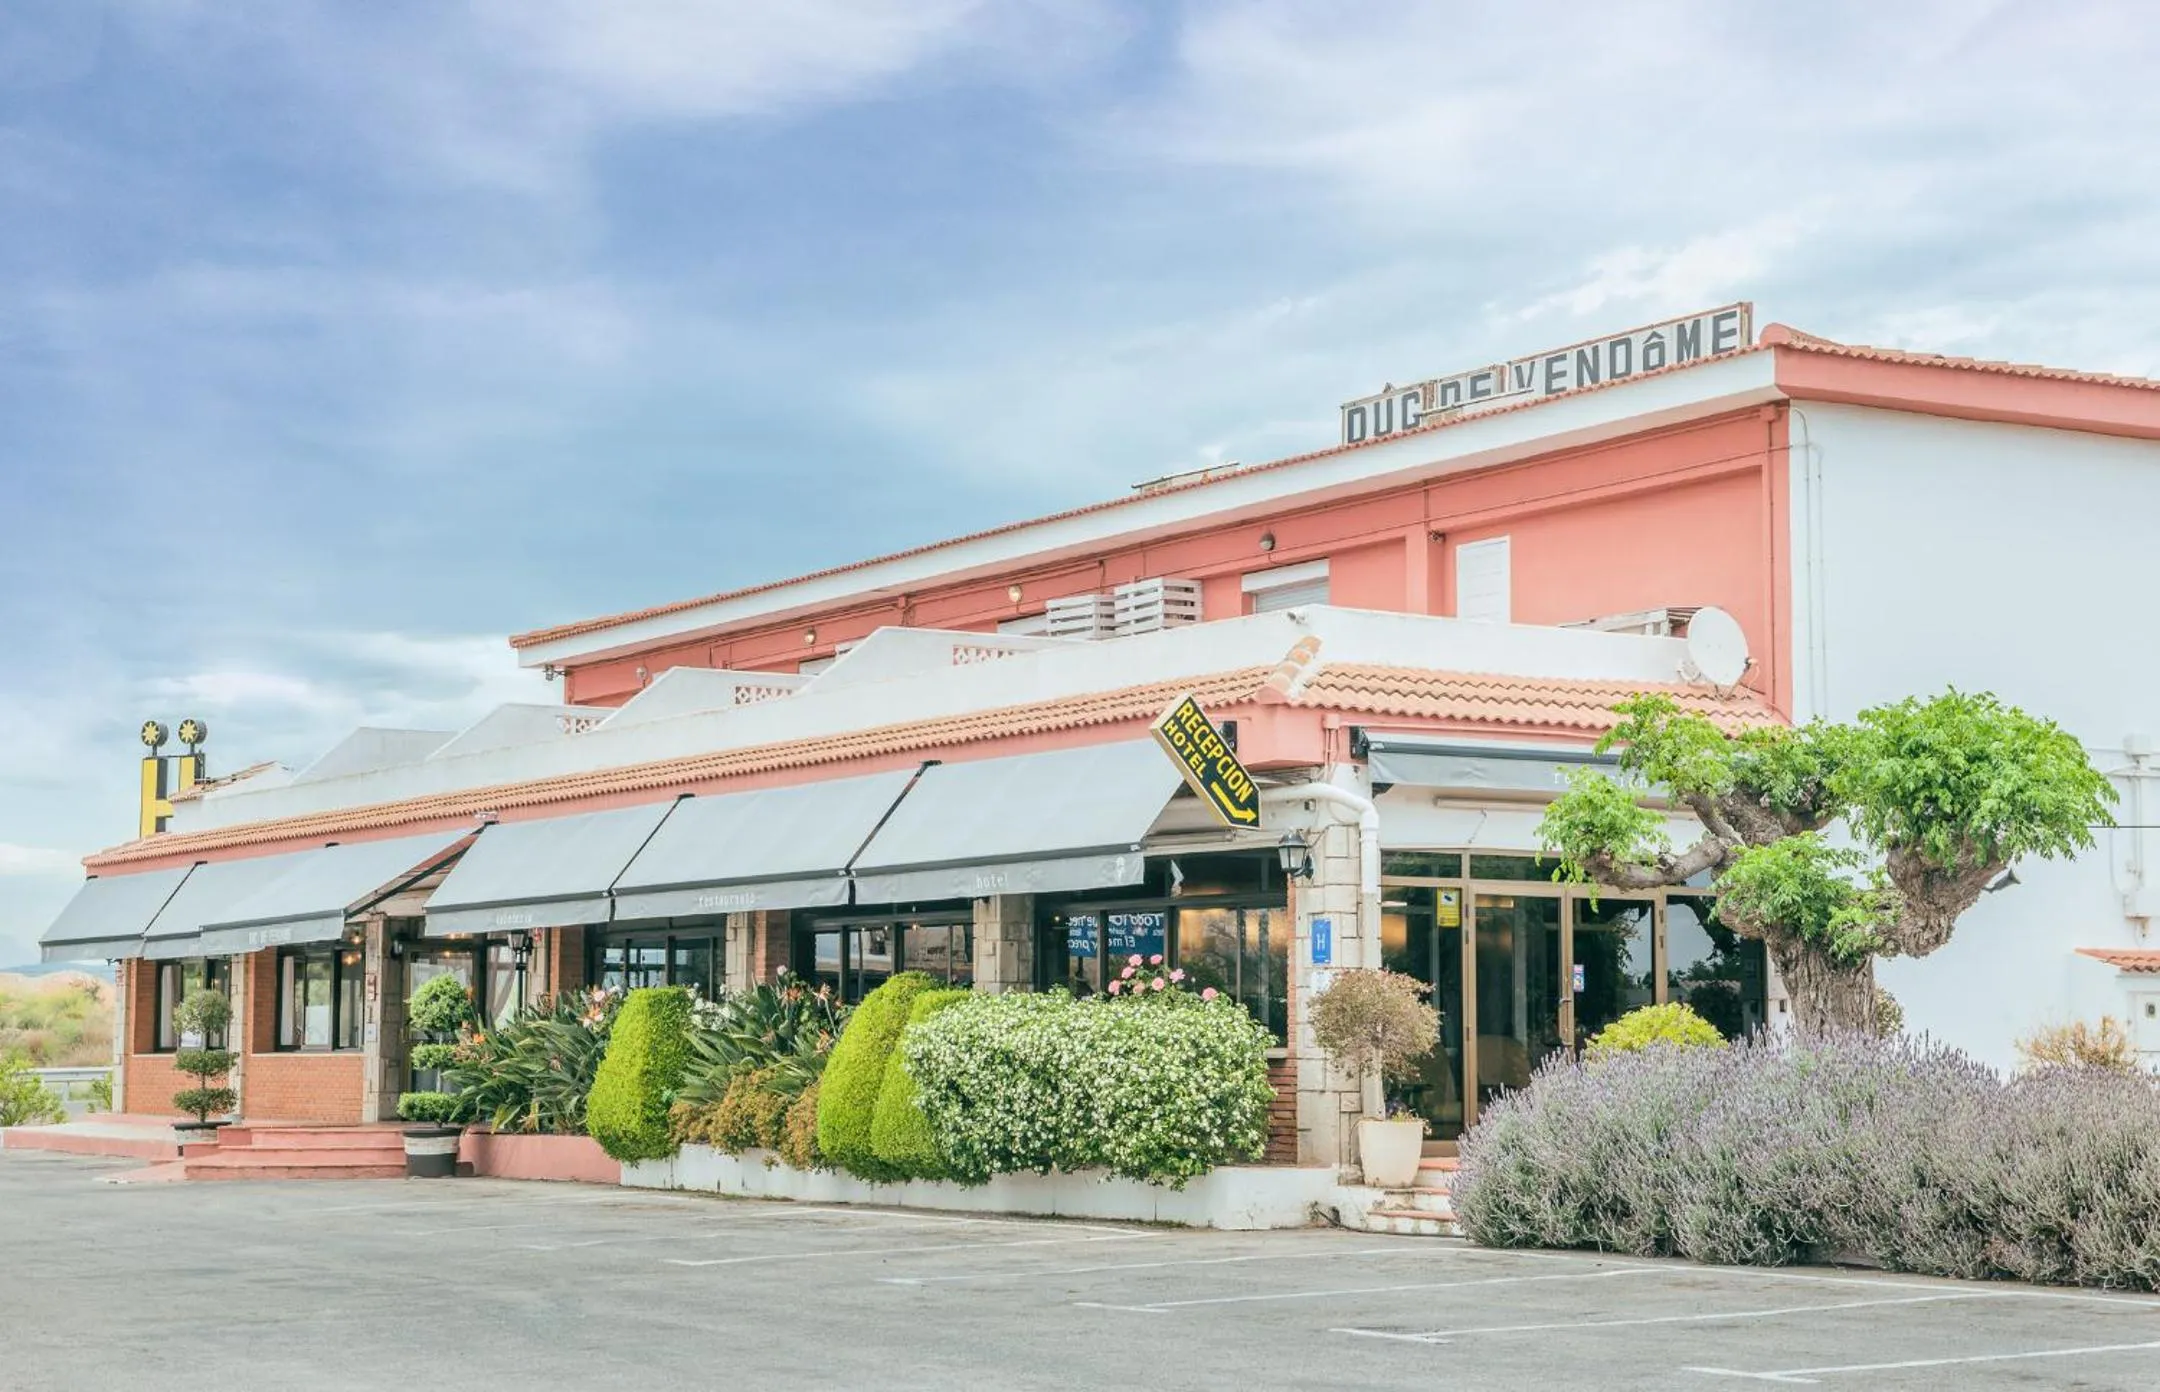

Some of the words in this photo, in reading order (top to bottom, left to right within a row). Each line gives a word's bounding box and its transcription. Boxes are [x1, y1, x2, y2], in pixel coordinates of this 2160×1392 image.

[1163, 719, 1206, 779] HOTEL
[1176, 701, 1253, 803] RECEPCION
[976, 873, 1008, 889] hotel
